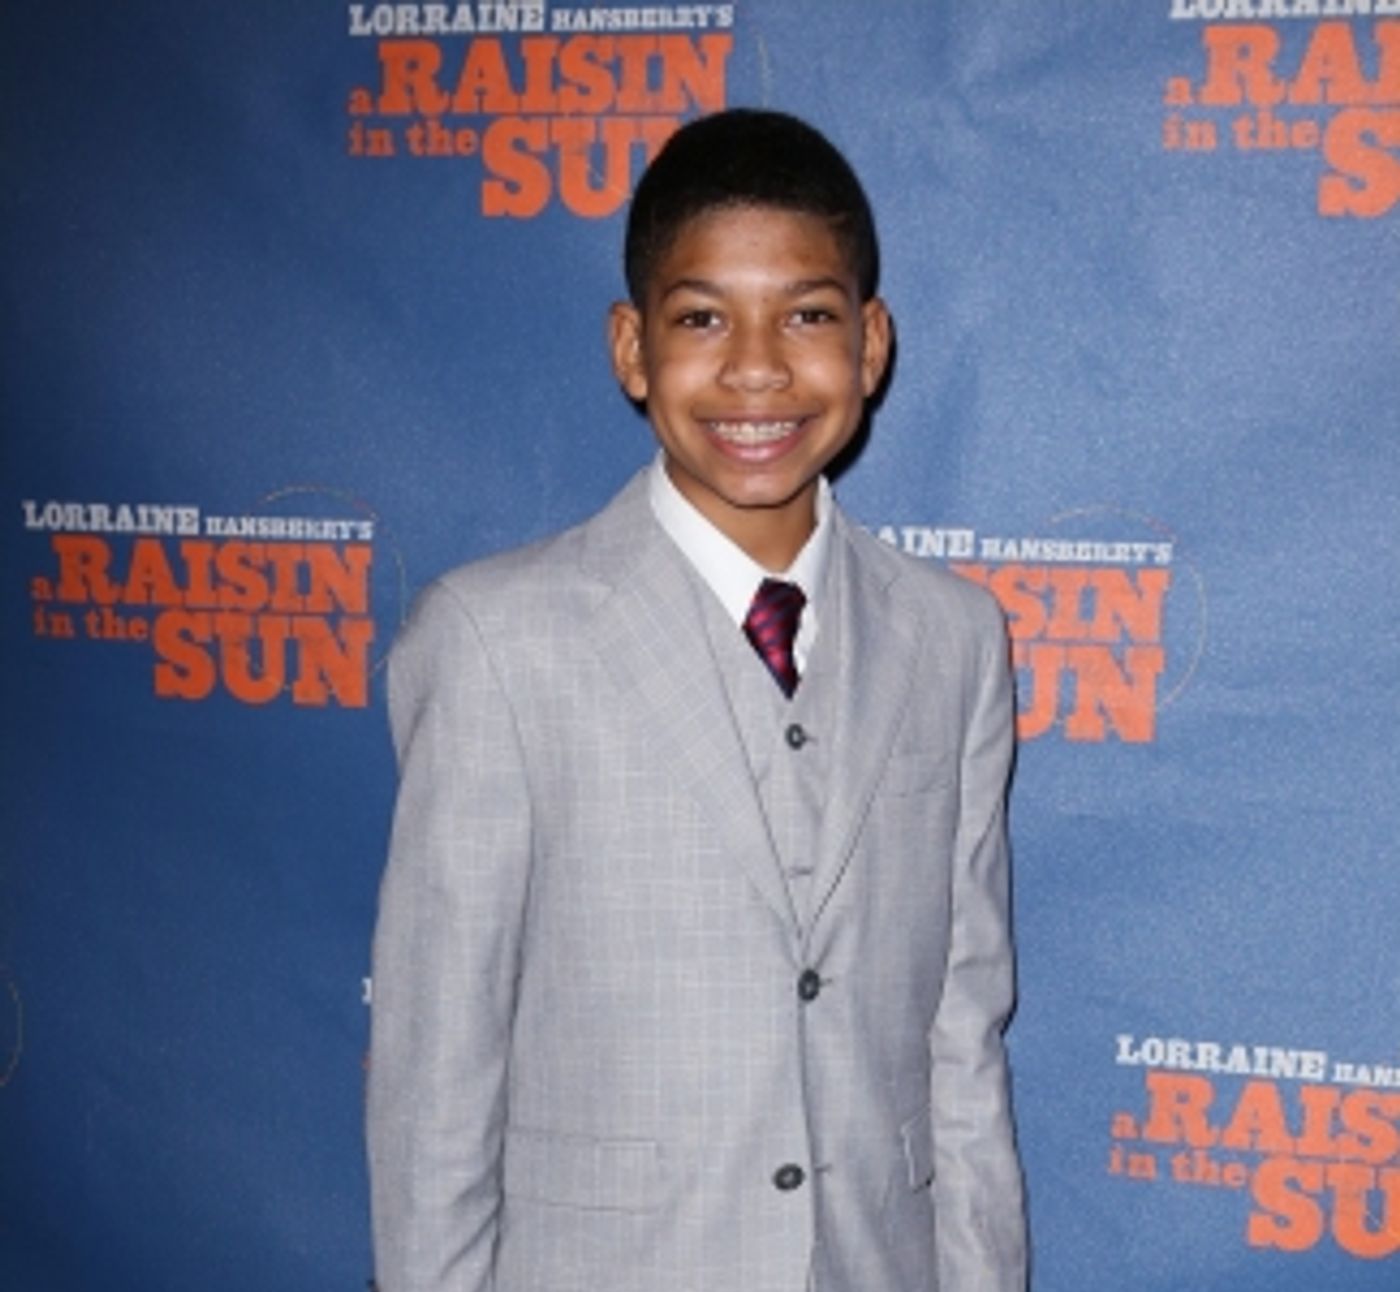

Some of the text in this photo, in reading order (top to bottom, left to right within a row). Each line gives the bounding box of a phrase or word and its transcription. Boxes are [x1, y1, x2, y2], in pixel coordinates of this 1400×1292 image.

[349, 0, 734, 36] LORRAINE HANSBERRY'S
[348, 34, 734, 117] a RAISIN
[1163, 76, 1192, 105] a
[348, 122, 395, 156] in
[406, 112, 478, 156] the
[1162, 112, 1217, 149] in
[1232, 109, 1320, 149] the
[22, 500, 374, 540] LORRAINE HANSBERRY'S
[981, 538, 1174, 564] HANSBERRY'S
[30, 534, 374, 614] a RAISIN
[33, 606, 375, 708] in the SUN
[1115, 1033, 1328, 1081] LORRAINE
[1110, 1069, 1400, 1164] a RAIS
[1108, 1145, 1156, 1180] in
[1170, 1149, 1247, 1188] the
